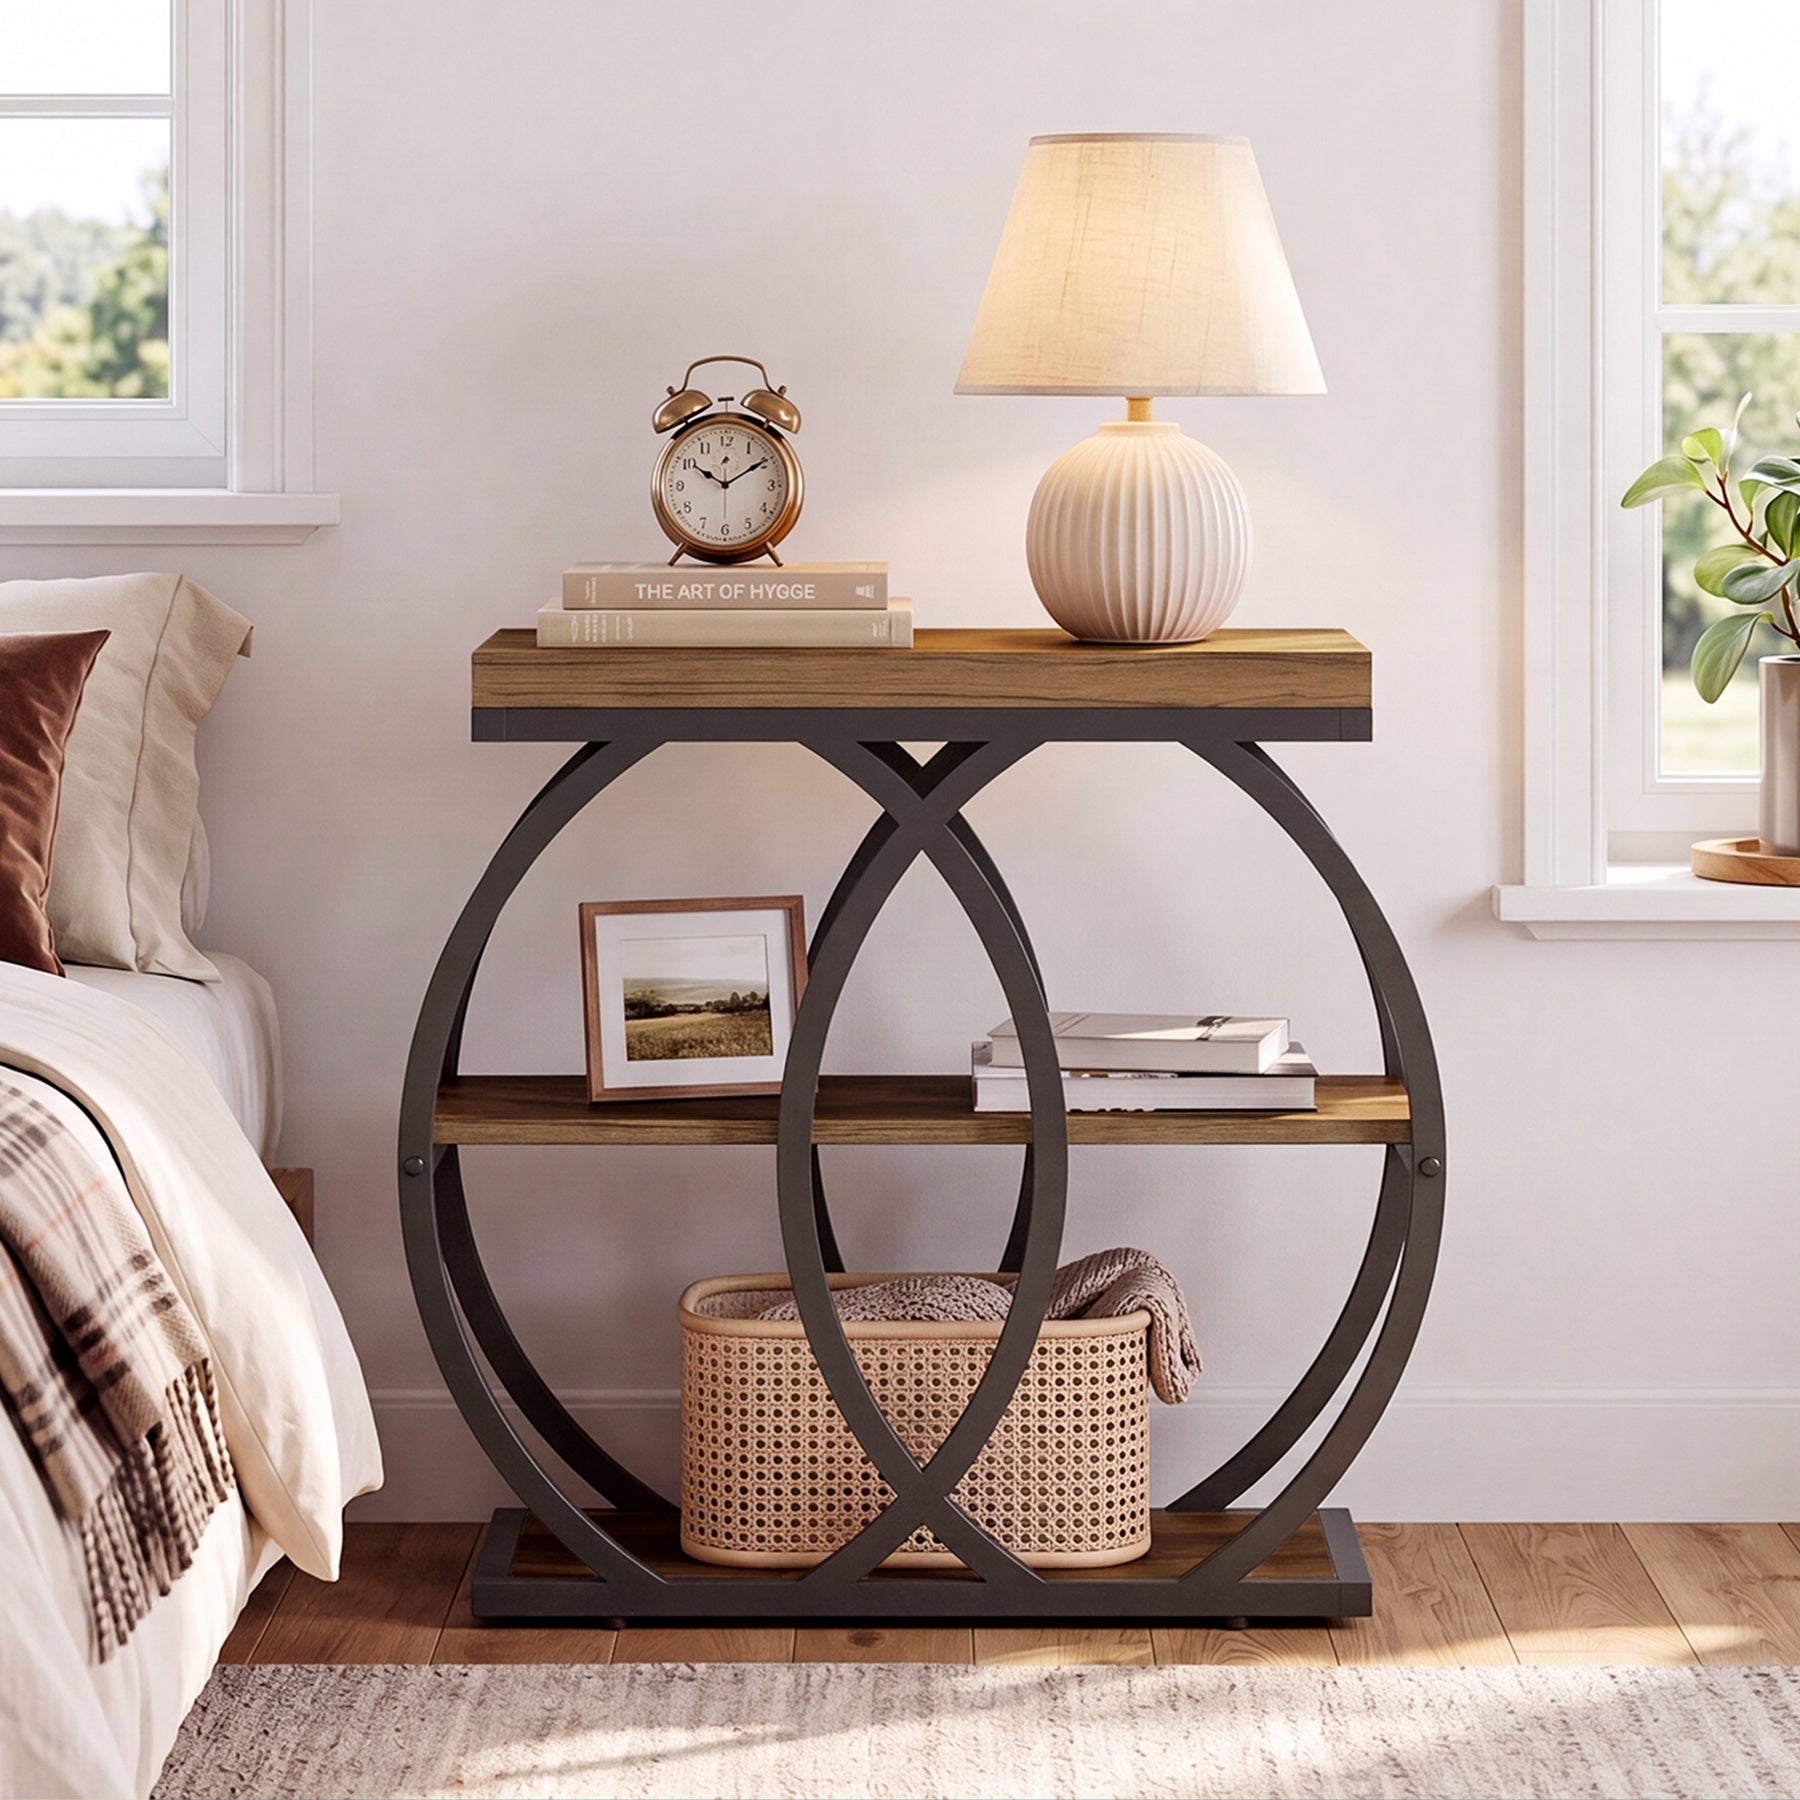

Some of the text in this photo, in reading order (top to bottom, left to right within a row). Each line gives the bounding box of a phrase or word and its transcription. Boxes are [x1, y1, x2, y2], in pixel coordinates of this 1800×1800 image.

[719, 435, 734, 447] 12
[699, 441, 711, 455] 11
[746, 441, 752, 455] 1
[682, 457, 697, 471] 10
[767, 479, 776, 492] 3
[759, 501, 767, 514] 4
[699, 516, 707, 530] 7
[720, 523, 730, 536] 6
[744, 517, 752, 530] 5
[635, 583, 816, 600] THE ART OF HYGGE
